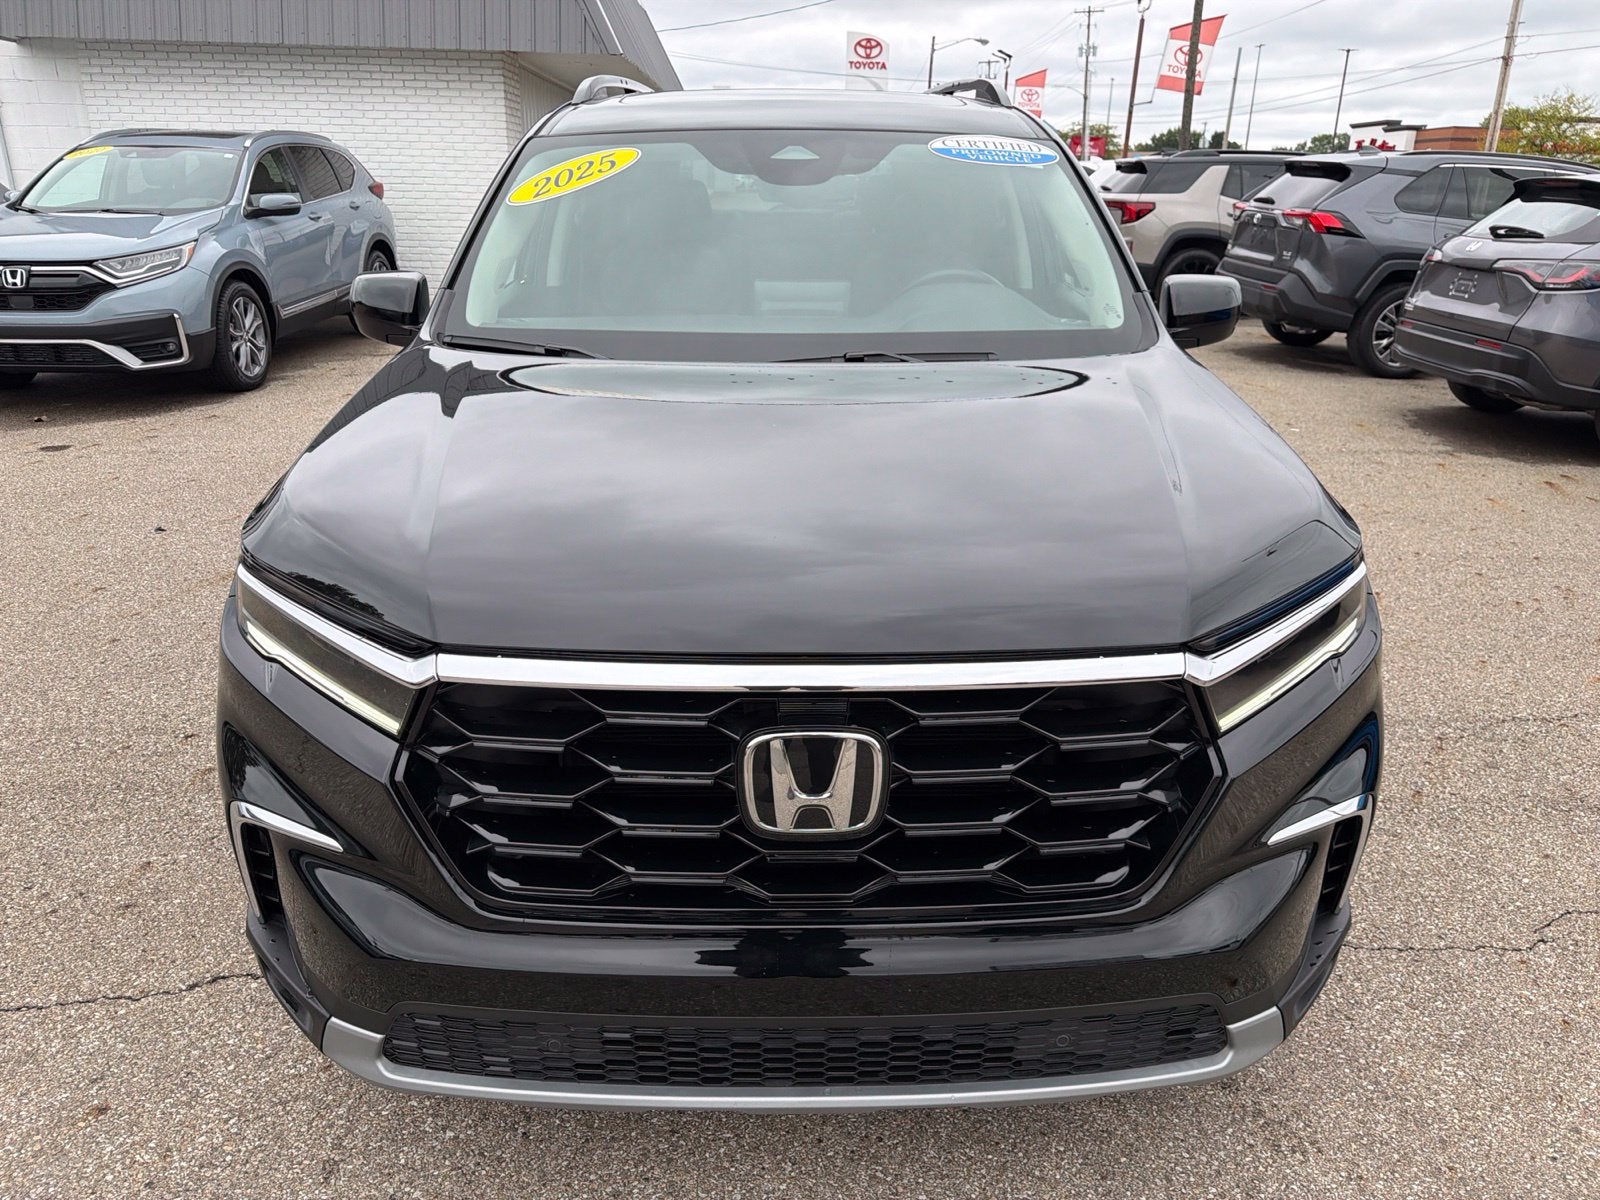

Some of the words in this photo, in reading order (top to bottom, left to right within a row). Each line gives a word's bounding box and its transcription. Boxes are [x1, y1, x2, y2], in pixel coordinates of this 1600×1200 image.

[848, 61, 887, 70] TOYOTA
[1167, 64, 1202, 79] TOYA
[942, 139, 1041, 153] CERTIFIED
[950, 148, 1041, 160] PRE-OWNED
[967, 153, 1032, 163] VEHICLE
[532, 152, 616, 198] 2025
